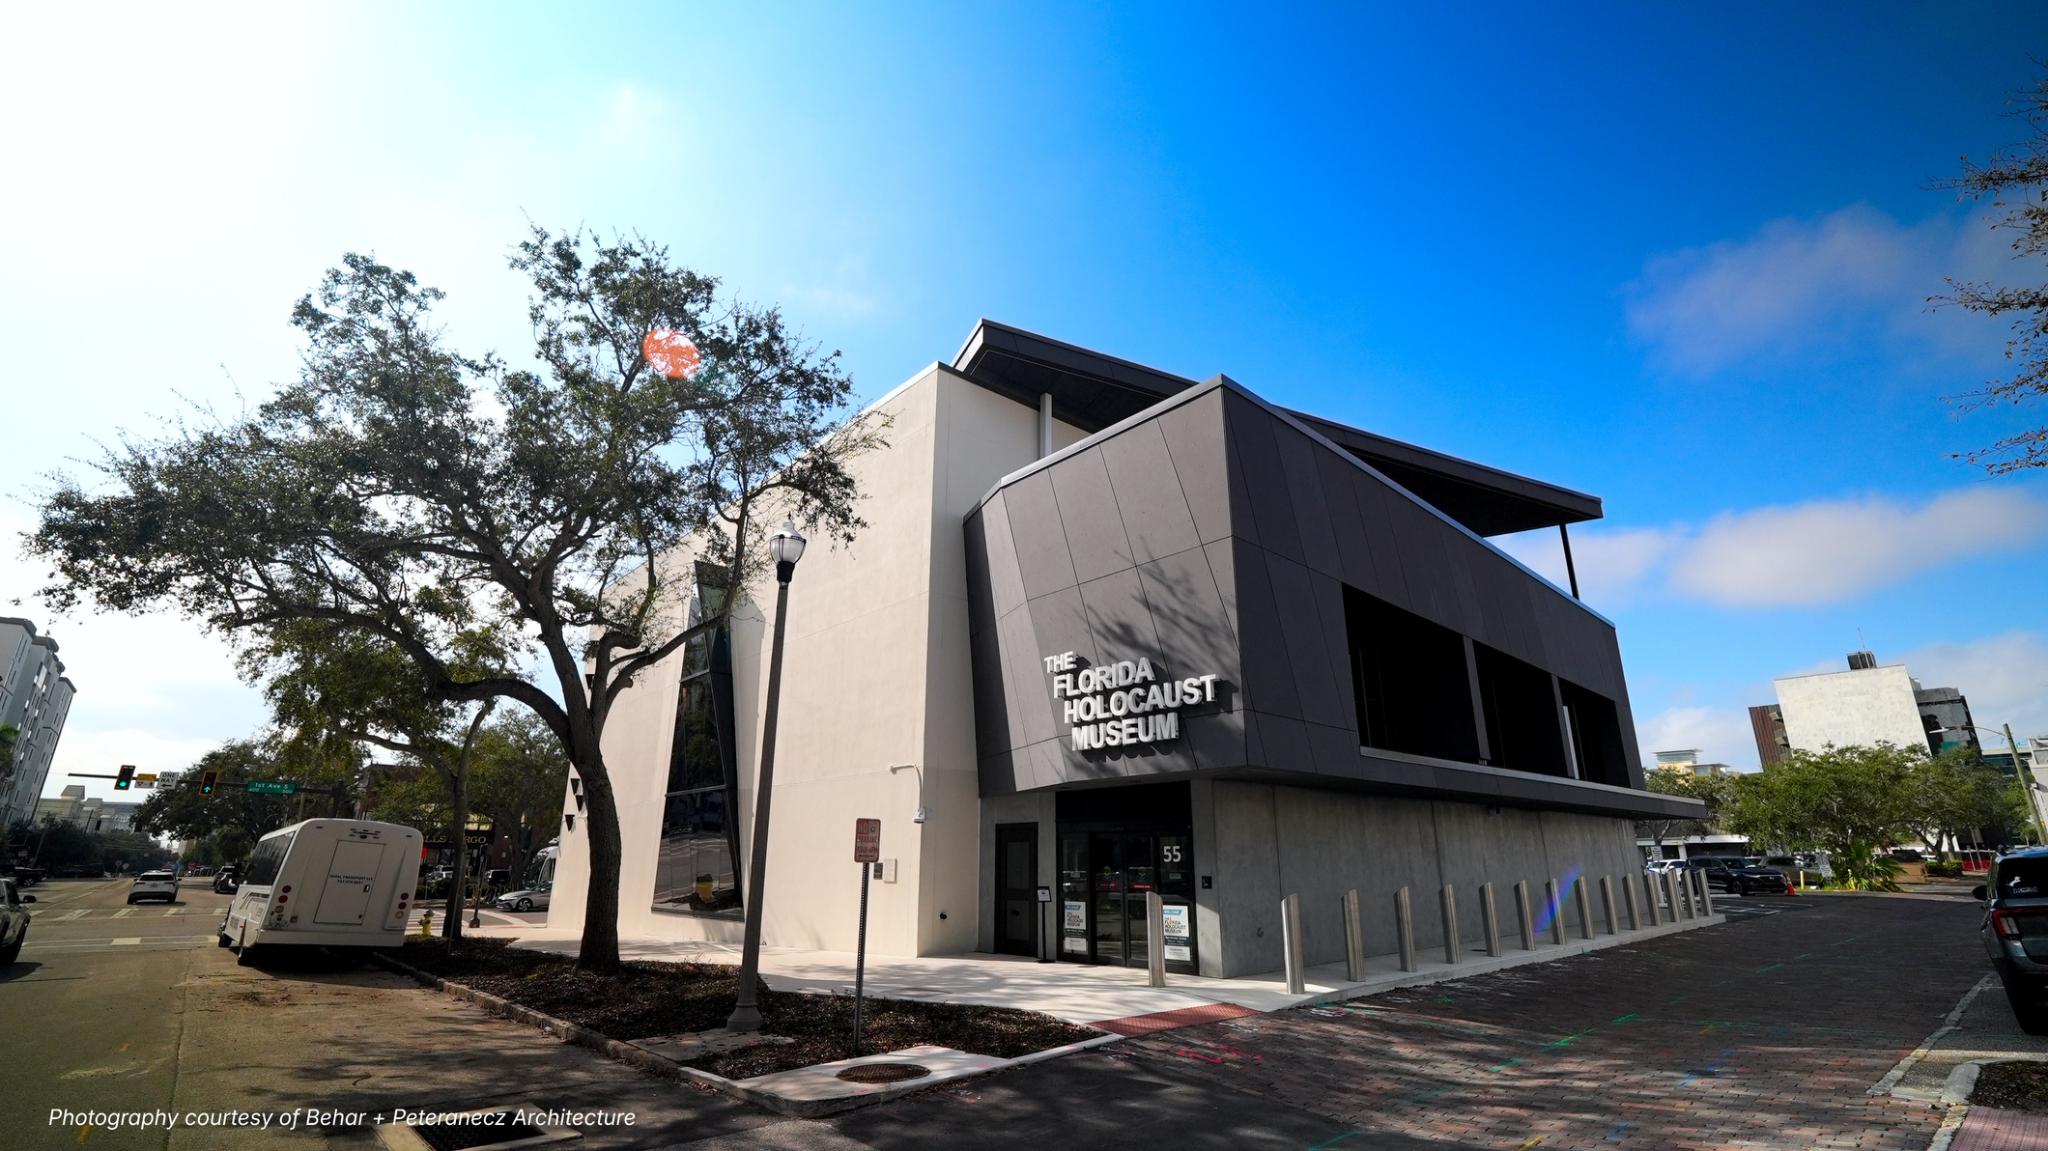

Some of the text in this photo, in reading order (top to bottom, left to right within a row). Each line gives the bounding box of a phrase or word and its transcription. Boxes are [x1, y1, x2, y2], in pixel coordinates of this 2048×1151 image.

[1044, 651, 1077, 674] THE
[1054, 657, 1156, 698] FLORIDA
[1064, 673, 1219, 723] HOLOCAUST
[1072, 712, 1180, 751] MUSEUM
[858, 822, 868, 833] NO
[1163, 845, 1182, 863] 55
